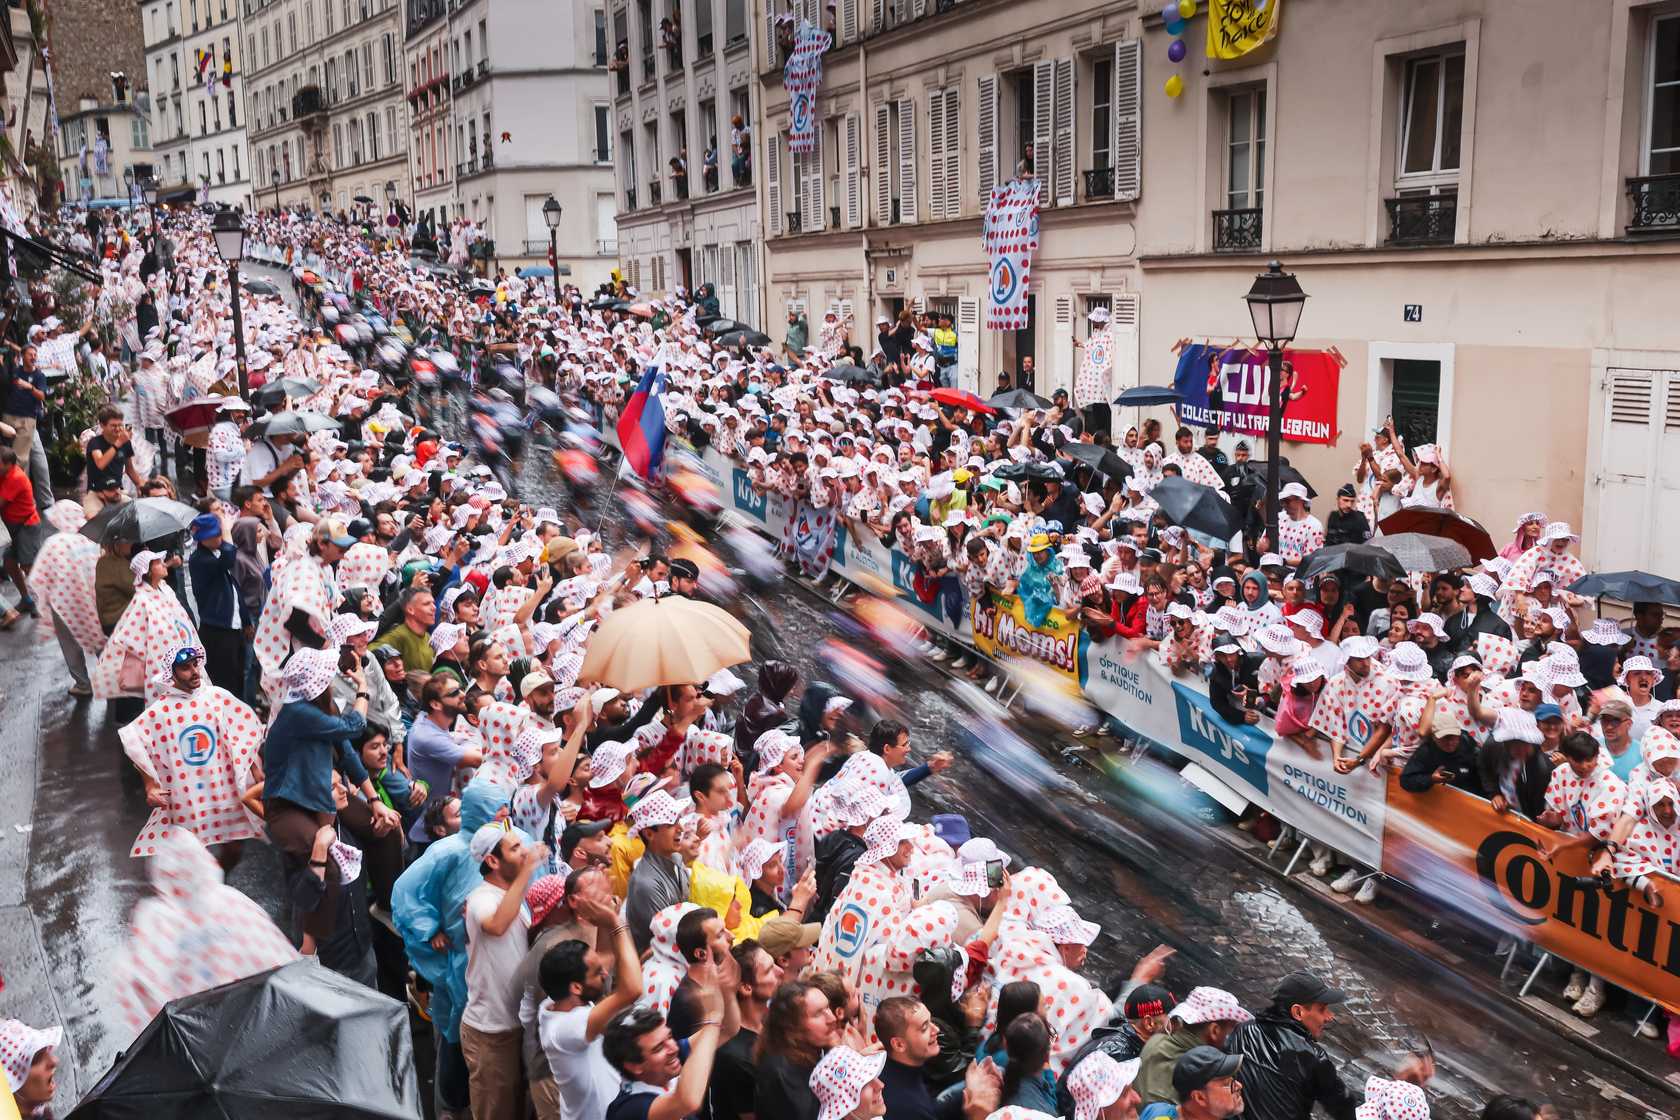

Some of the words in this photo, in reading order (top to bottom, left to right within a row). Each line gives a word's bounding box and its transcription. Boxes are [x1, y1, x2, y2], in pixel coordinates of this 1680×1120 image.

[1407, 306, 1420, 320] 74
[1181, 404, 1231, 426] COLLECTIF
[1281, 418, 1329, 439] LEBRUN
[997, 611, 1076, 672] Moms!
[1099, 657, 1140, 685] OPTIQUE
[1100, 670, 1108, 680] &
[1110, 674, 1152, 705] AUDITION
[1186, 701, 1250, 766] Krys
[1283, 764, 1347, 800] OPTIQUE
[1297, 785, 1368, 825] AUDITION
